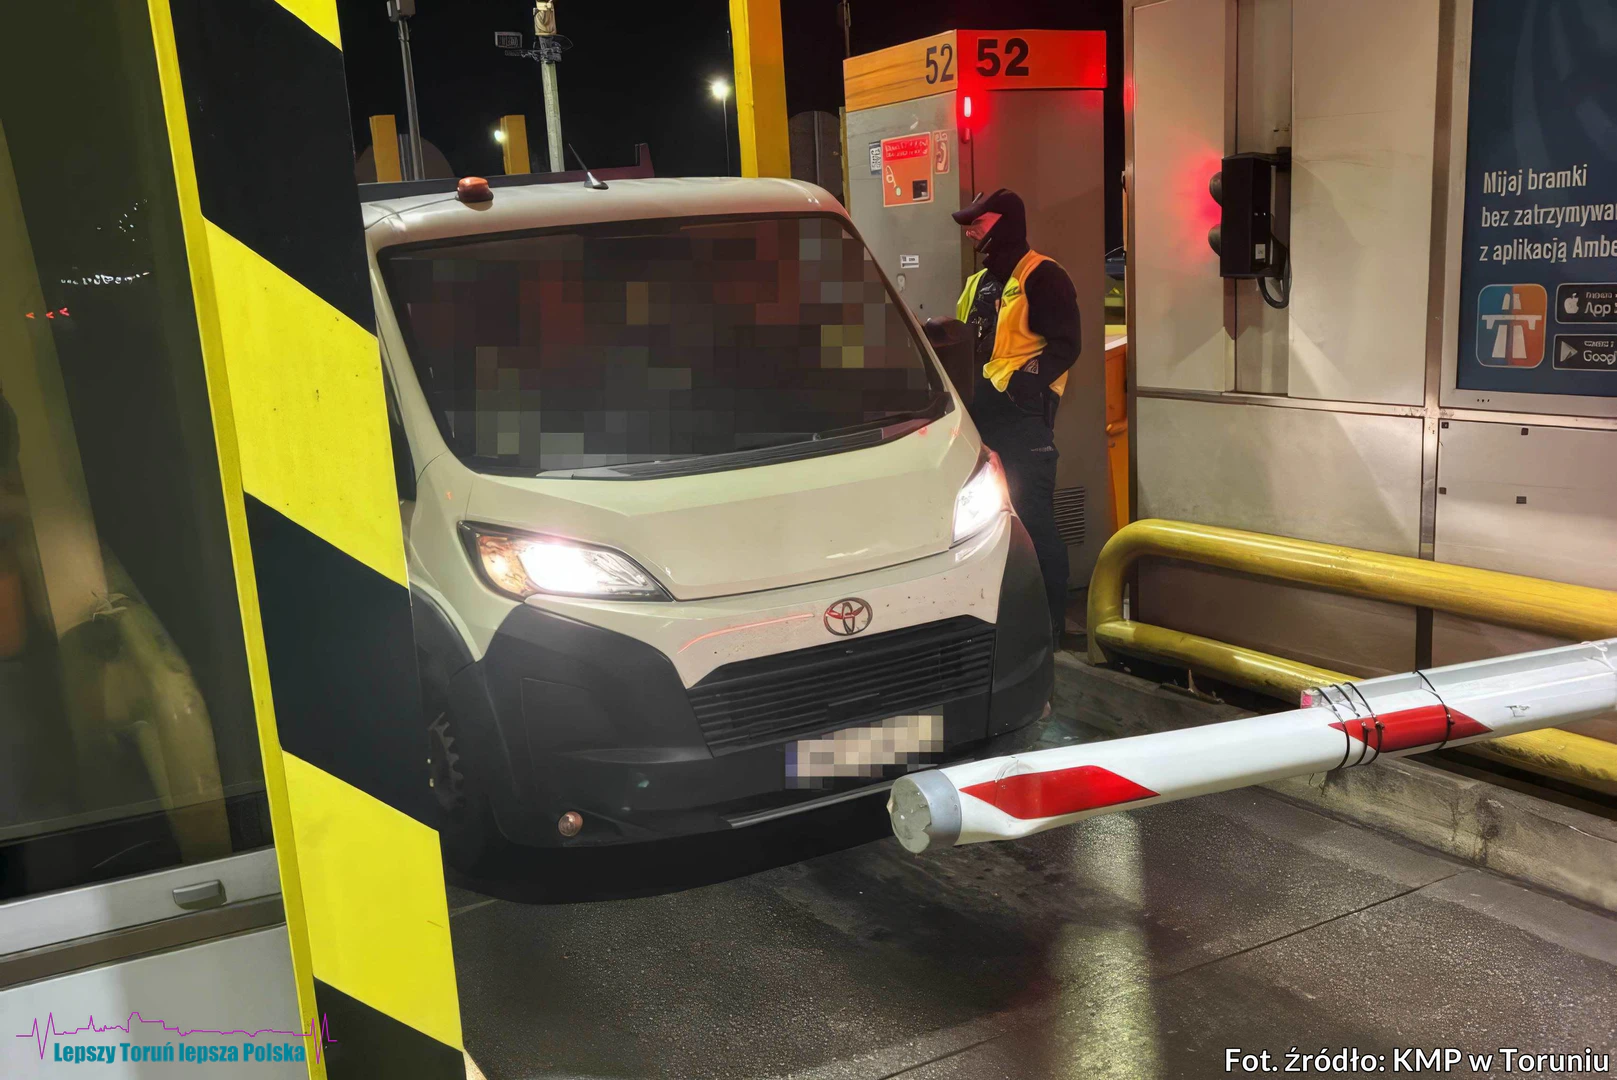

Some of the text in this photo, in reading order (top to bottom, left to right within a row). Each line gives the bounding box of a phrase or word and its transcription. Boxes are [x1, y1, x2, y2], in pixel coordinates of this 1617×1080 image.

[925, 43, 954, 84] 52
[976, 37, 1029, 77] 52
[1483, 164, 1588, 196] Mijaj bramki
[1481, 203, 1617, 228] bez zatrzymywa
[1479, 245, 1488, 262] z
[1493, 237, 1567, 265] aplikacją
[1584, 301, 1611, 317] App
